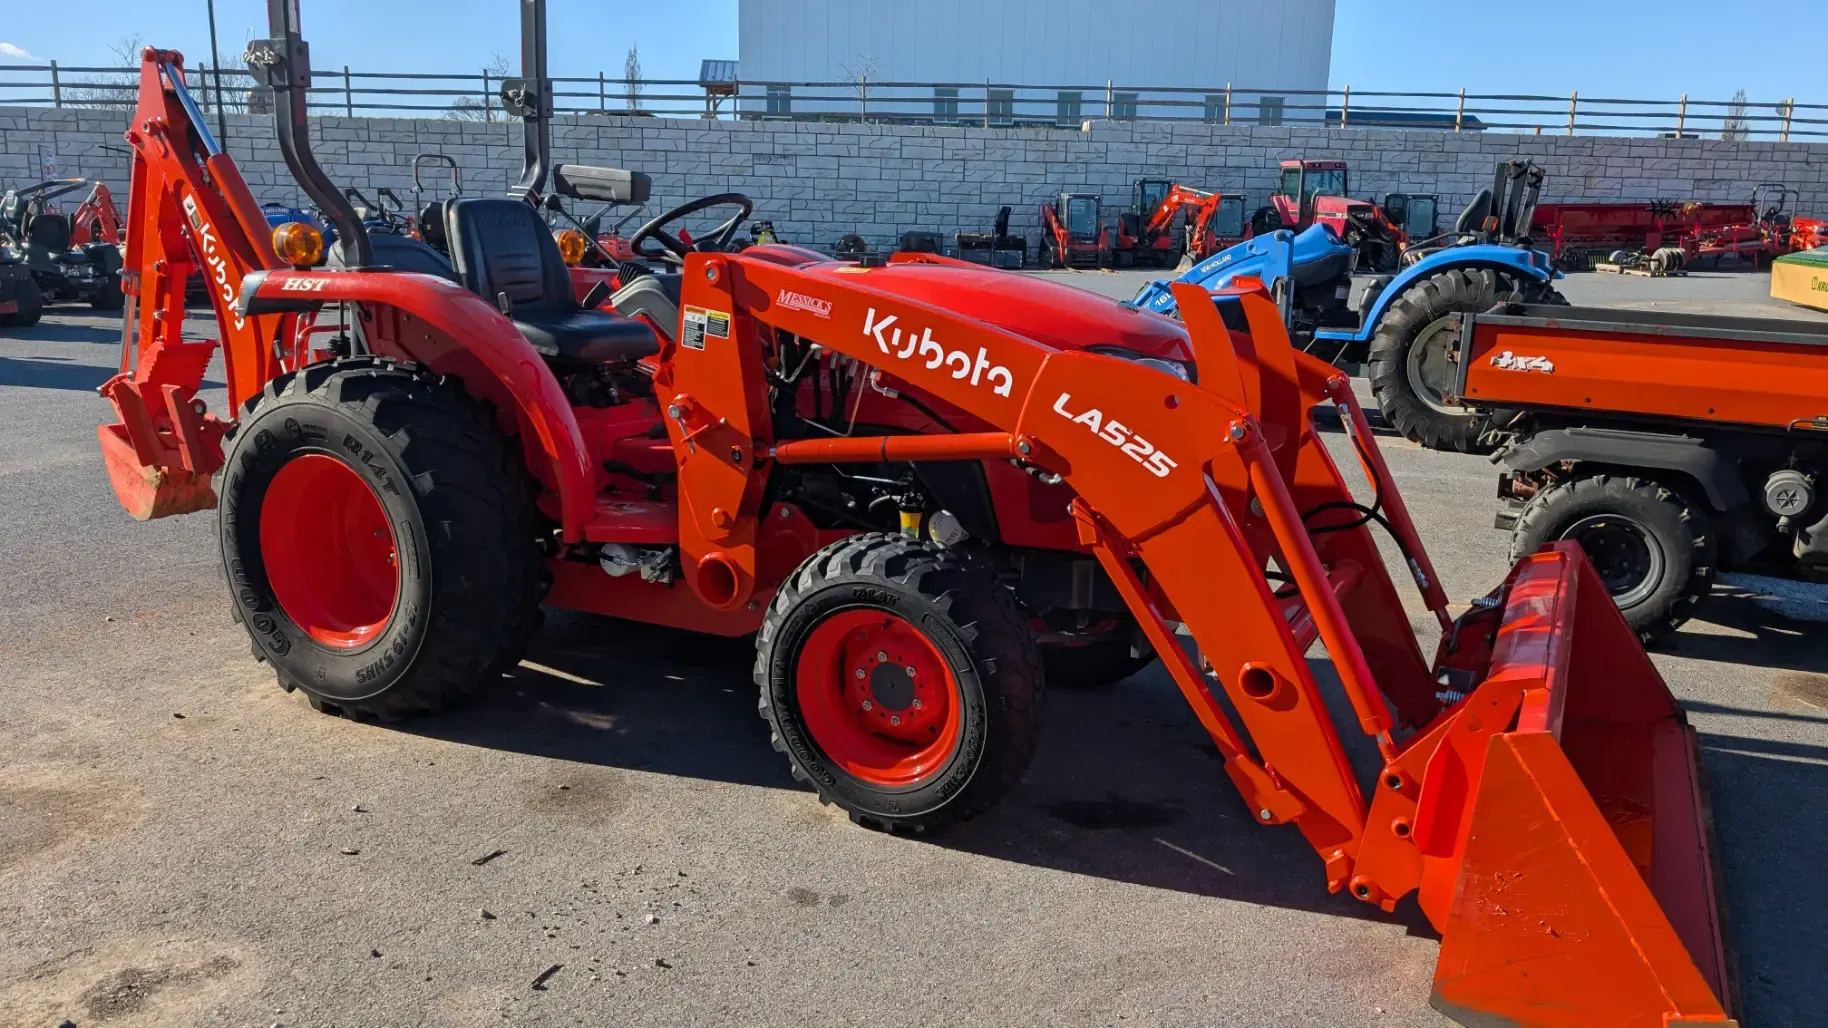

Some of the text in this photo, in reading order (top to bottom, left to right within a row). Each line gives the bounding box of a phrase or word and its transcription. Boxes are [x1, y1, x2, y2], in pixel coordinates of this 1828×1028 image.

[281, 277, 331, 291] HST
[776, 288, 833, 312] MESSICK'S
[863, 307, 1013, 398] Kubota
[343, 434, 400, 497] R14T
[1053, 392, 1178, 477] LA525
